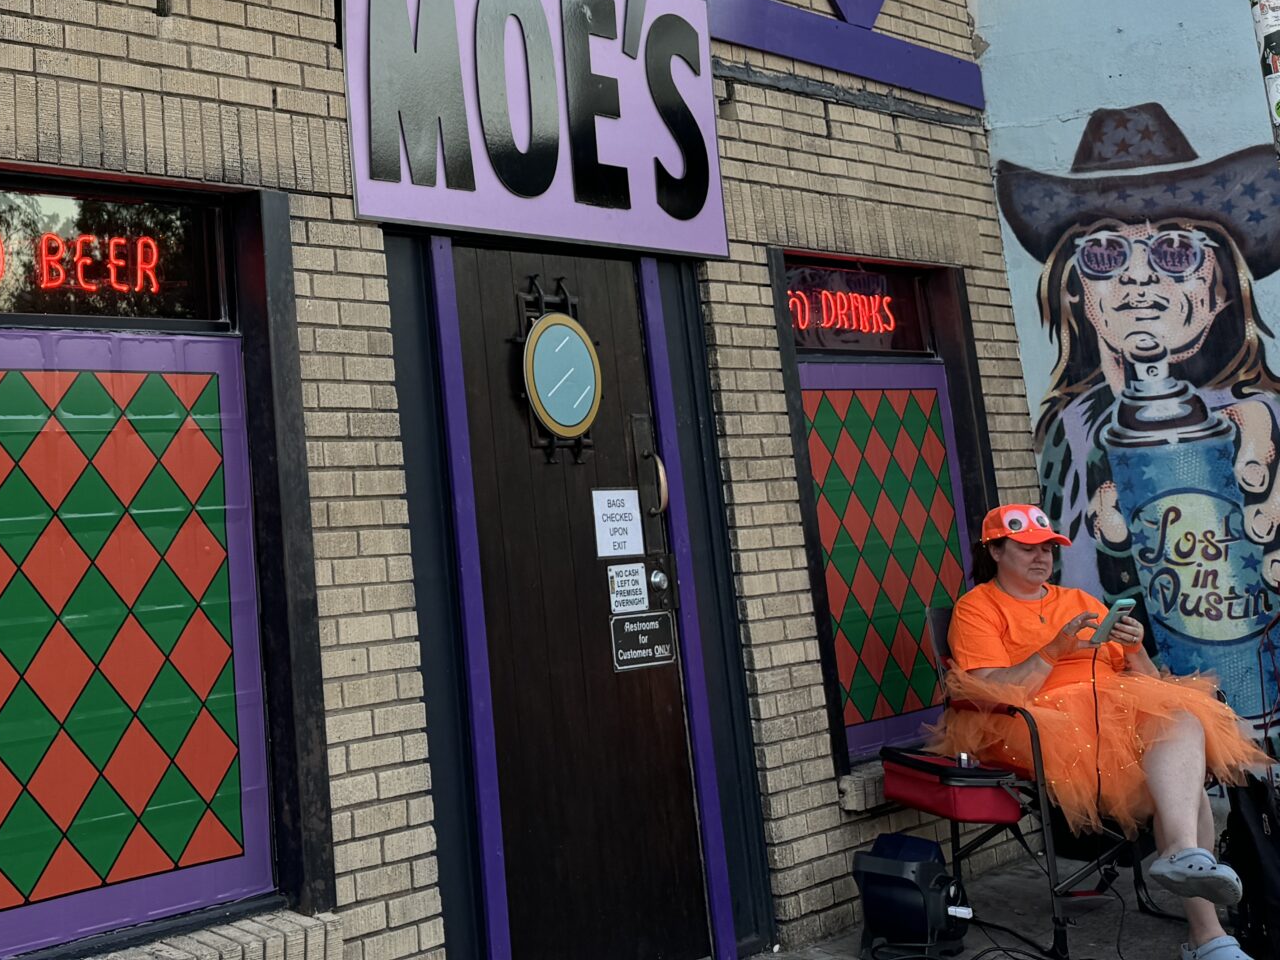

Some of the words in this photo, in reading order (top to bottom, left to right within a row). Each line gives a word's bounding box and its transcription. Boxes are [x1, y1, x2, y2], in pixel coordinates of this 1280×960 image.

[39, 231, 161, 295] BEER
[821, 289, 896, 334] DRINKS
[607, 498, 625, 508] BAGS
[601, 512, 633, 522] CHECKED
[609, 526, 628, 536] UPON
[1137, 505, 1241, 567] Lost
[612, 540, 627, 550] EXIT
[615, 570, 624, 578] NO
[624, 569, 639, 578] CASH
[1191, 562, 1220, 590] in
[616, 579, 630, 588] LEFT
[615, 588, 643, 597] PREMISES
[614, 597, 645, 608] OVERNIGHT
[624, 620, 660, 633] Restrooms
[638, 633, 649, 644] for
[618, 648, 653, 660] Customers
[653, 644, 671, 657] ONLY
